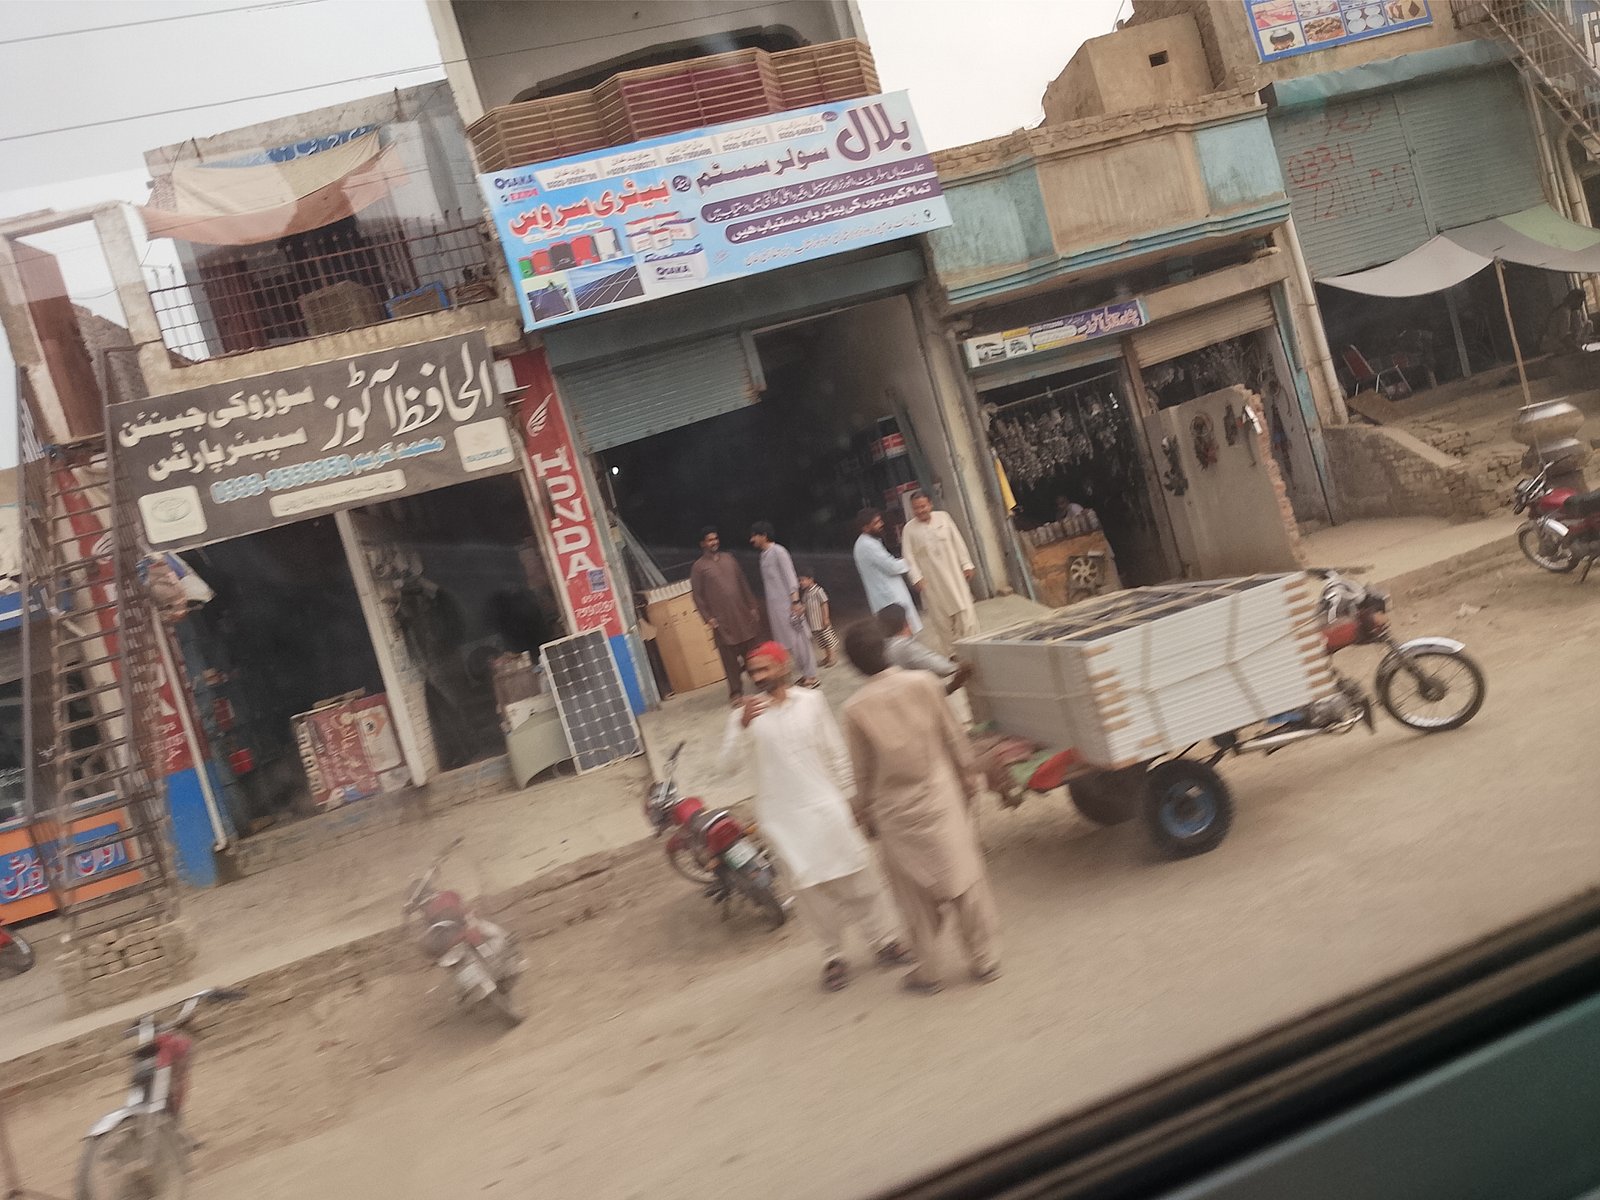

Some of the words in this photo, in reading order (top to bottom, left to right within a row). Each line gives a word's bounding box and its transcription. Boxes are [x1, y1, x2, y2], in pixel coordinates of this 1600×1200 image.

[836, 102, 911, 161] بلال
[696, 159, 770, 195] سسٹم
[775, 147, 830, 175] سولر
[509, 198, 591, 237] سروس
[591, 177, 671, 217] بیٹری
[208, 386, 315, 428] سوزوکی
[321, 359, 399, 451] آٹوز
[392, 342, 493, 437] الحافظ
[148, 439, 225, 481] پارٹس
[532, 445, 597, 580] HONDA
